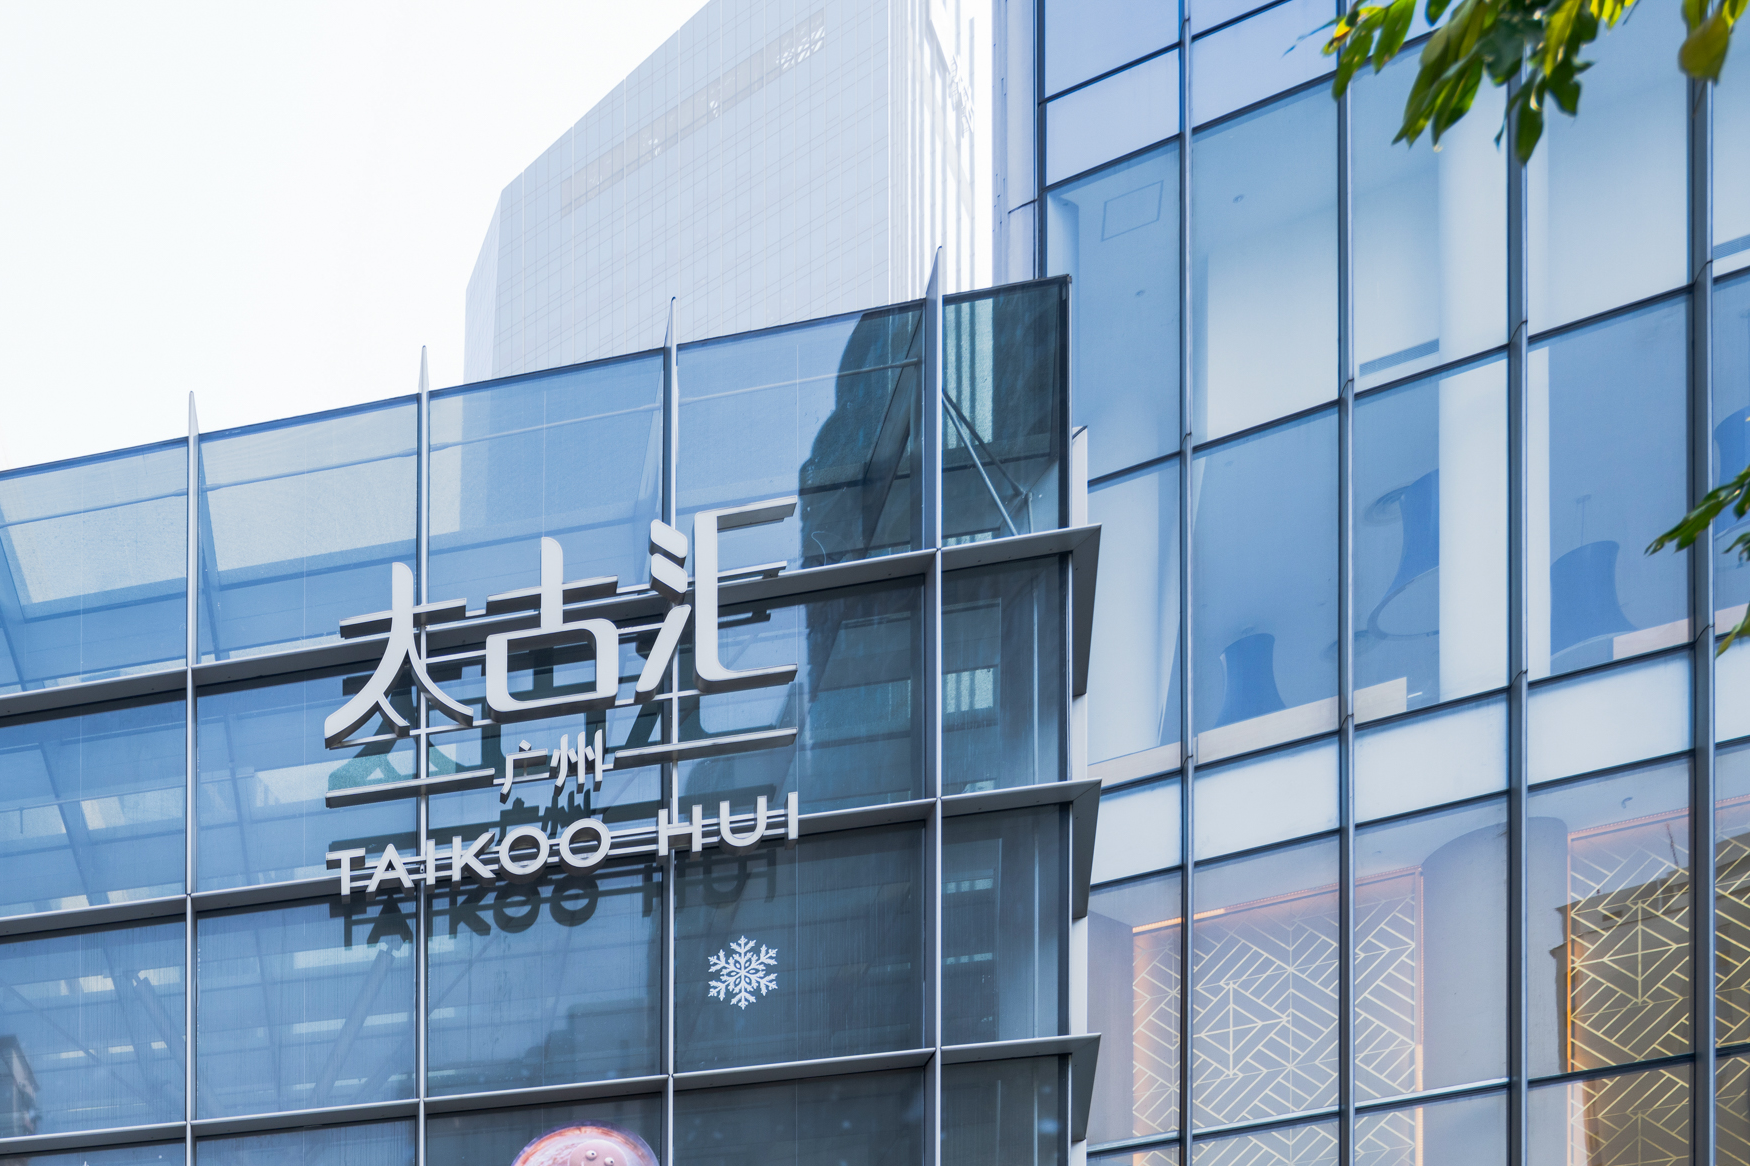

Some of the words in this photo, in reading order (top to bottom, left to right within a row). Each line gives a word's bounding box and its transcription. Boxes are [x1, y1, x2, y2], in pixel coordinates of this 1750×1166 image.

[324, 495, 798, 749] 太古汇
[500, 729, 604, 804] 广州
[325, 818, 611, 901] TAIKOO
[657, 791, 798, 857] HUI
